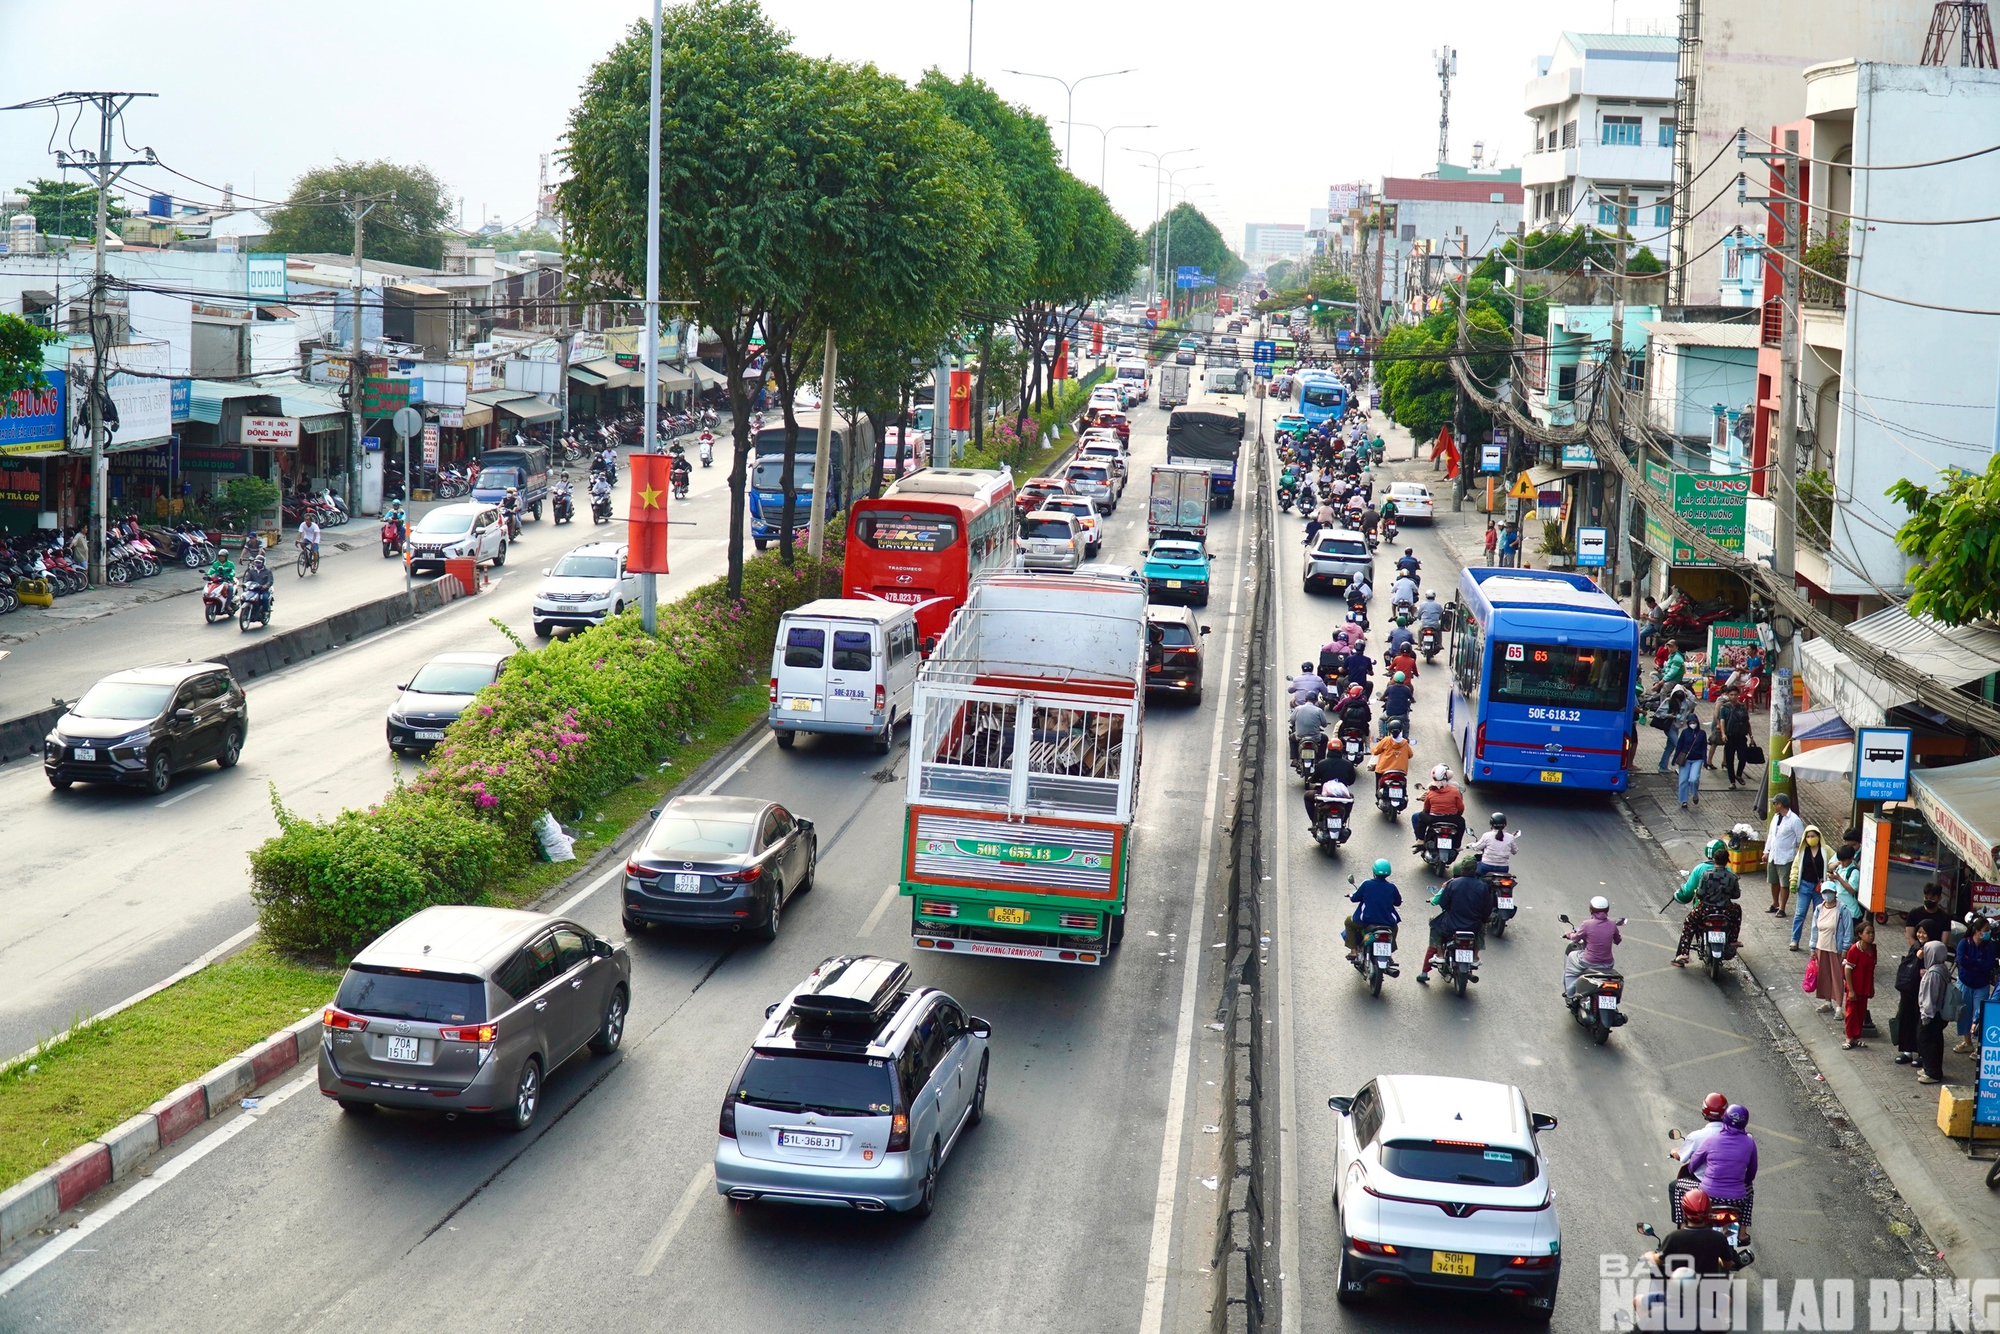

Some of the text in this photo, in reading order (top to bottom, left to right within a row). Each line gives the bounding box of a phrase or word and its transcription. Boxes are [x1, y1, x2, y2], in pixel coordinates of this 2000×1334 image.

[1694, 510, 1707, 519] HEO
[872, 529, 941, 542] HKC
[884, 592, 922, 603] 47B.023.76
[1508, 646, 1522, 658] 65
[1534, 650, 1548, 662] 65
[1528, 707, 1580, 722] 50E-618.32
[1859, 778, 1871, 787] ĐIỂM
[1885, 781, 1892, 789] XE
[927, 842, 944, 852] PK
[1084, 855, 1100, 865] PK
[681, 874, 694, 884] 51A
[675, 883, 699, 893] 827.53
[1002, 908, 1016, 916] 50E
[996, 915, 1022, 924] 655.13
[985, 945, 1007, 954] KHANG
[1007, 948, 1043, 958] TRANSPORT
[395, 1037, 411, 1049] 70A
[389, 1048, 416, 1060] 151.10
[784, 1134, 835, 1148] 51L-368.31
[1444, 1253, 1464, 1264] 50H
[1436, 1263, 1470, 1275] 341.51
[1347, 1281, 1362, 1291] VF5
[1533, 1297, 1549, 1307] VF5
